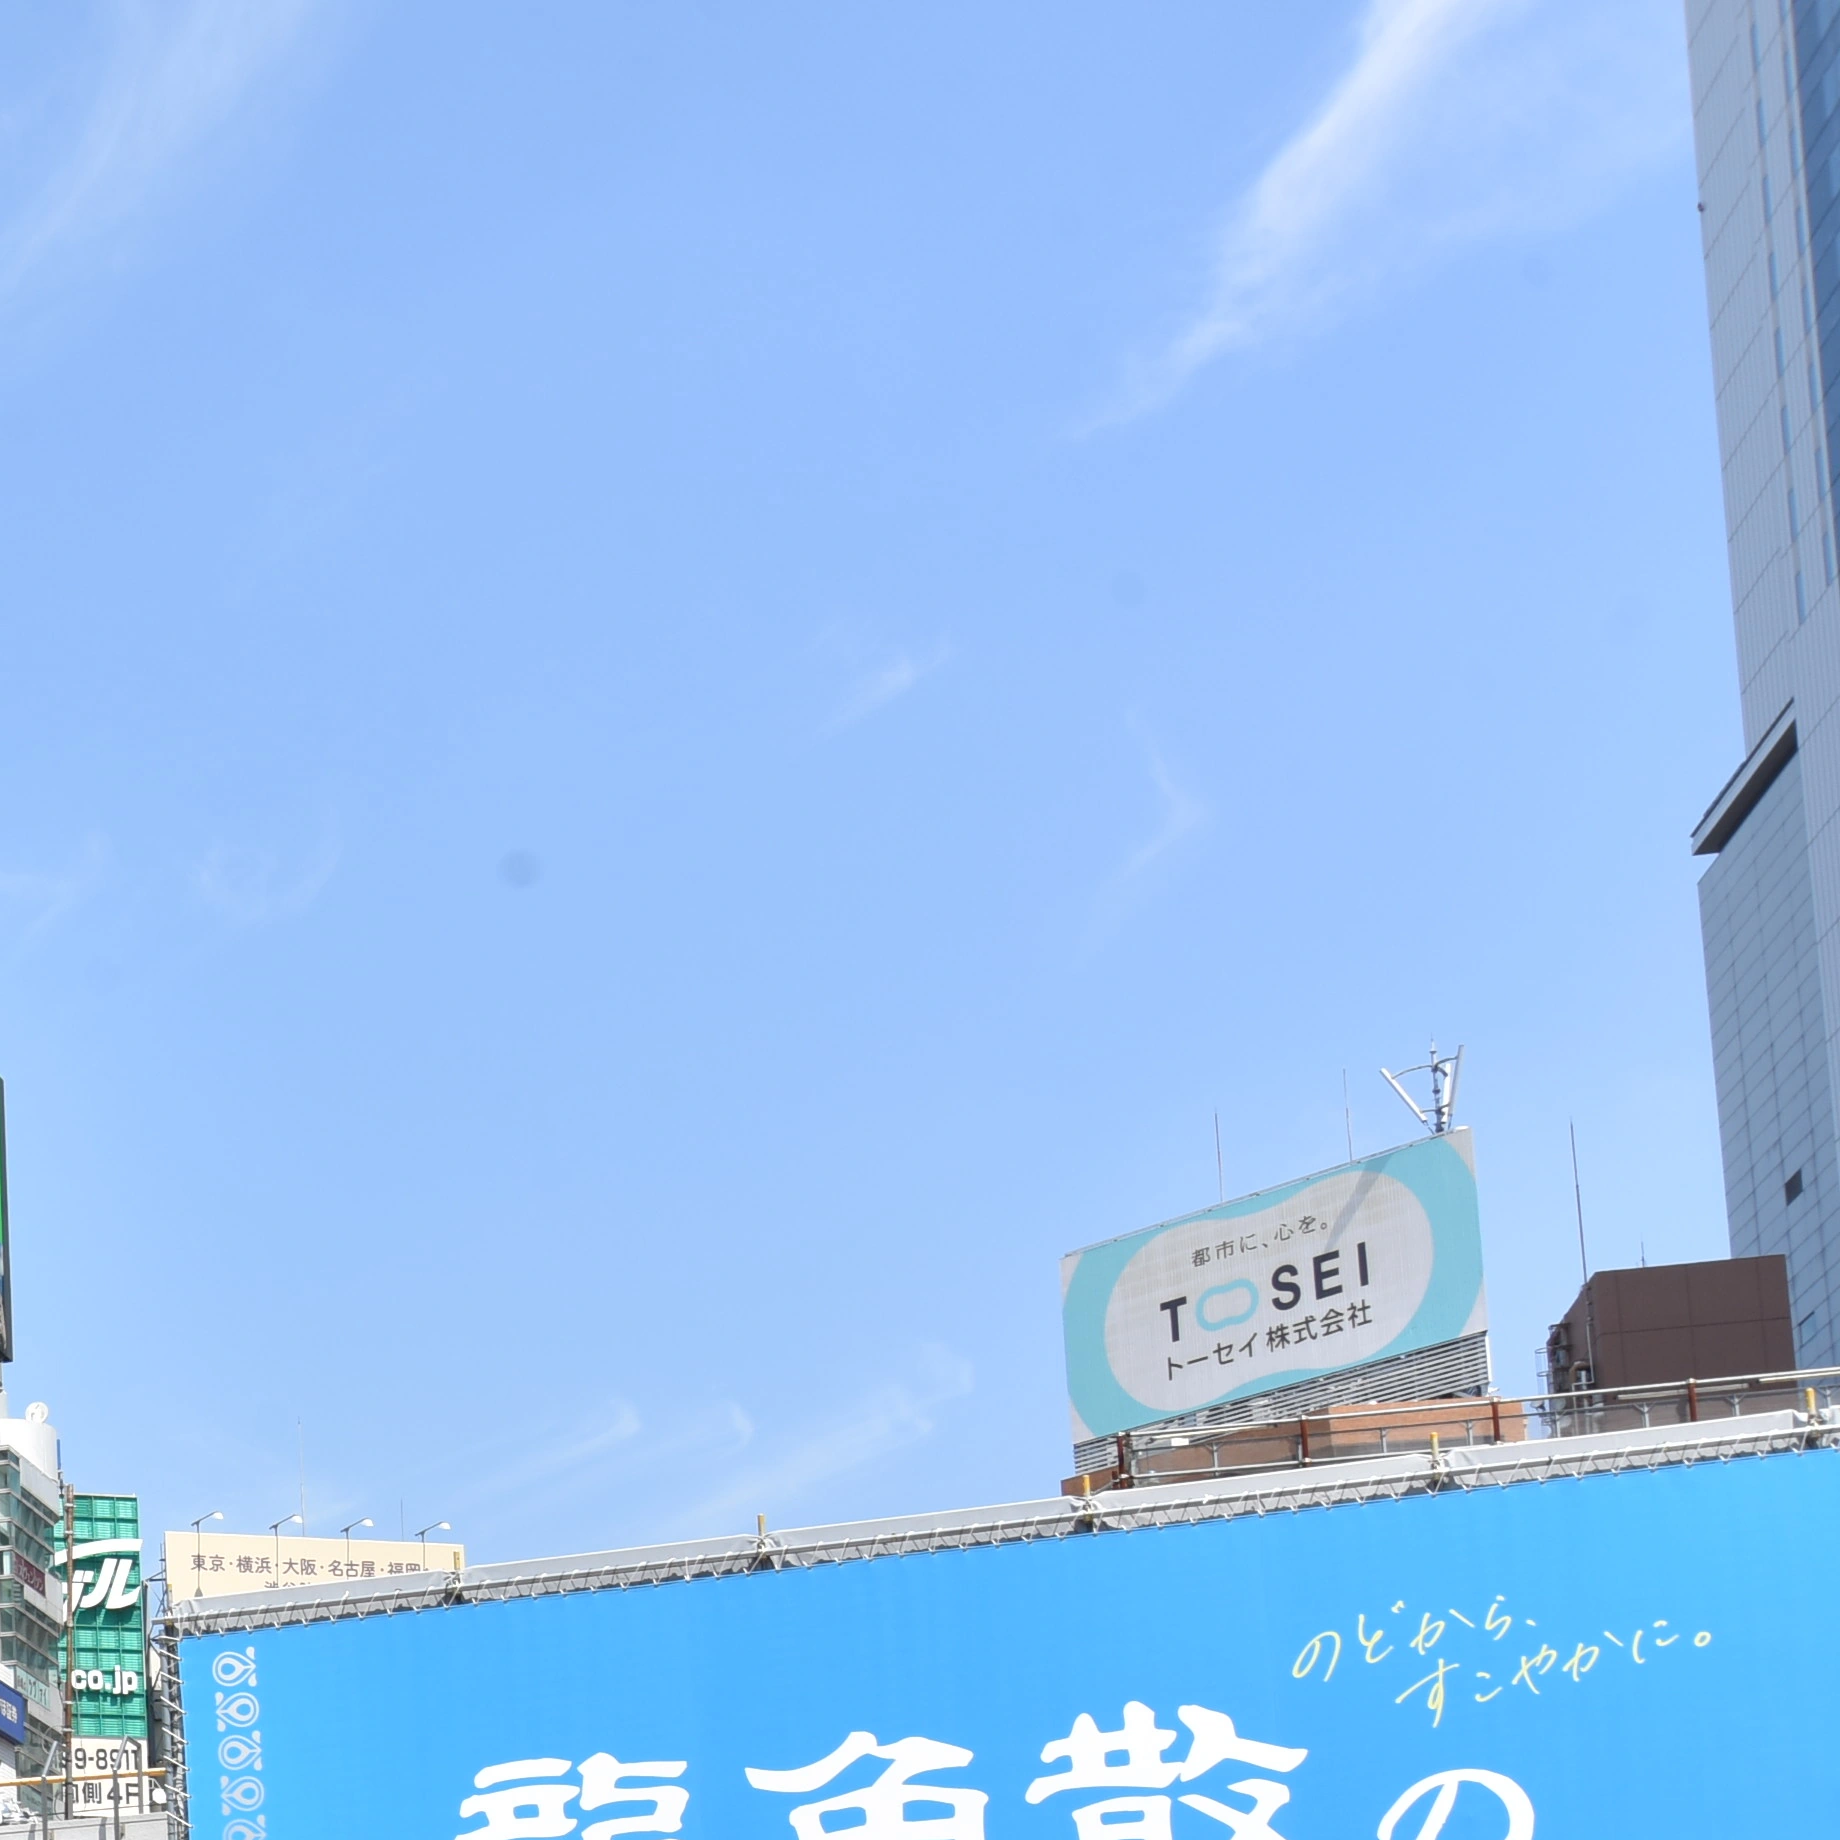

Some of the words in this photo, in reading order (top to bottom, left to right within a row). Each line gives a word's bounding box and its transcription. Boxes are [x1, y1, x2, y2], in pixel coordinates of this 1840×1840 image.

[1190, 1214, 1329, 1269] 都市に、心を。
[1160, 1241, 1371, 1342] TOSEI
[1166, 1300, 1373, 1381] トーセイ株式会社
[71, 1665, 139, 1695] co.jp
[1292, 1595, 1537, 1682] のどから、
[1395, 1620, 1712, 1727] すこやかに。
